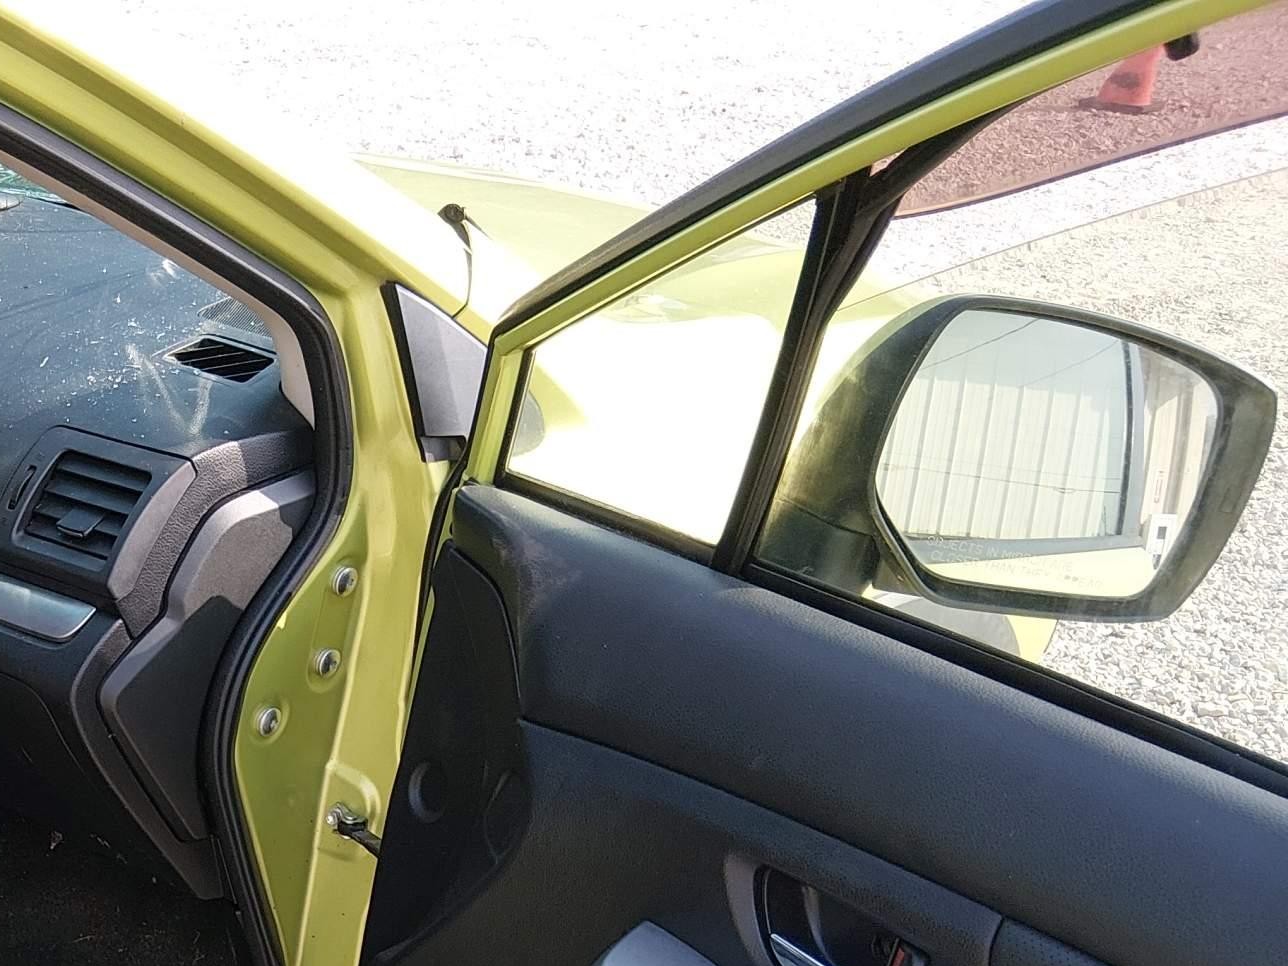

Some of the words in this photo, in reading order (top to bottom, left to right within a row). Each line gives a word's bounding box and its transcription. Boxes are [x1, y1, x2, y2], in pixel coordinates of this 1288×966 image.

[926, 535, 984, 554] OBJECTS
[988, 546, 1002, 559] IN
[985, 560, 1015, 575] THAN
[1055, 573, 1104, 588] AEAR
